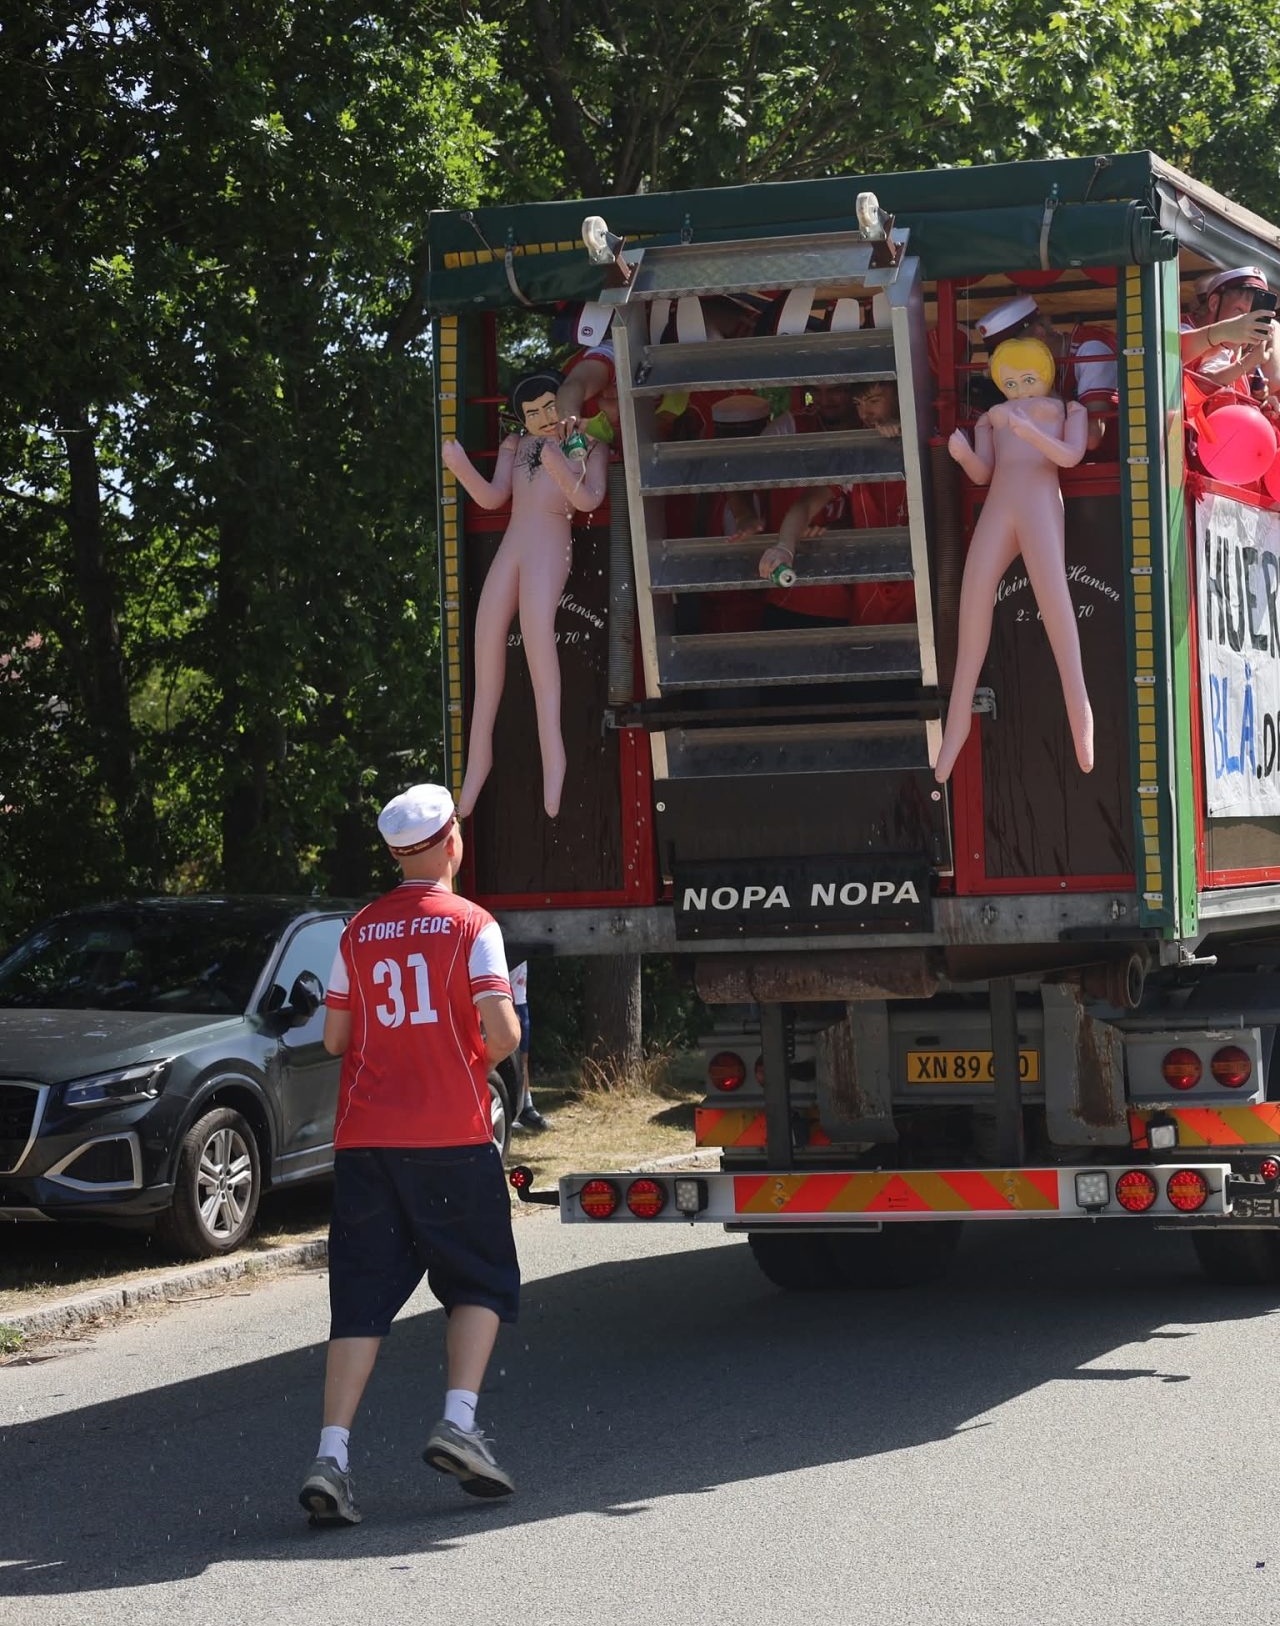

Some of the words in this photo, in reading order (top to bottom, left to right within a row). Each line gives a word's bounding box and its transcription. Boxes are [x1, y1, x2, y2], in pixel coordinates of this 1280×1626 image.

[1065, 564, 1121, 602] Hansen
[1077, 603, 1095, 619] 70
[564, 631, 580, 645] 70
[682, 885, 791, 912] NOPA
[809, 880, 921, 907] NOPA
[358, 919, 405, 944] STORE
[410, 916, 454, 936] FEDE
[372, 952, 439, 1029] 31
[916, 1056, 948, 1079] XN
[953, 1055, 981, 1078] 89
